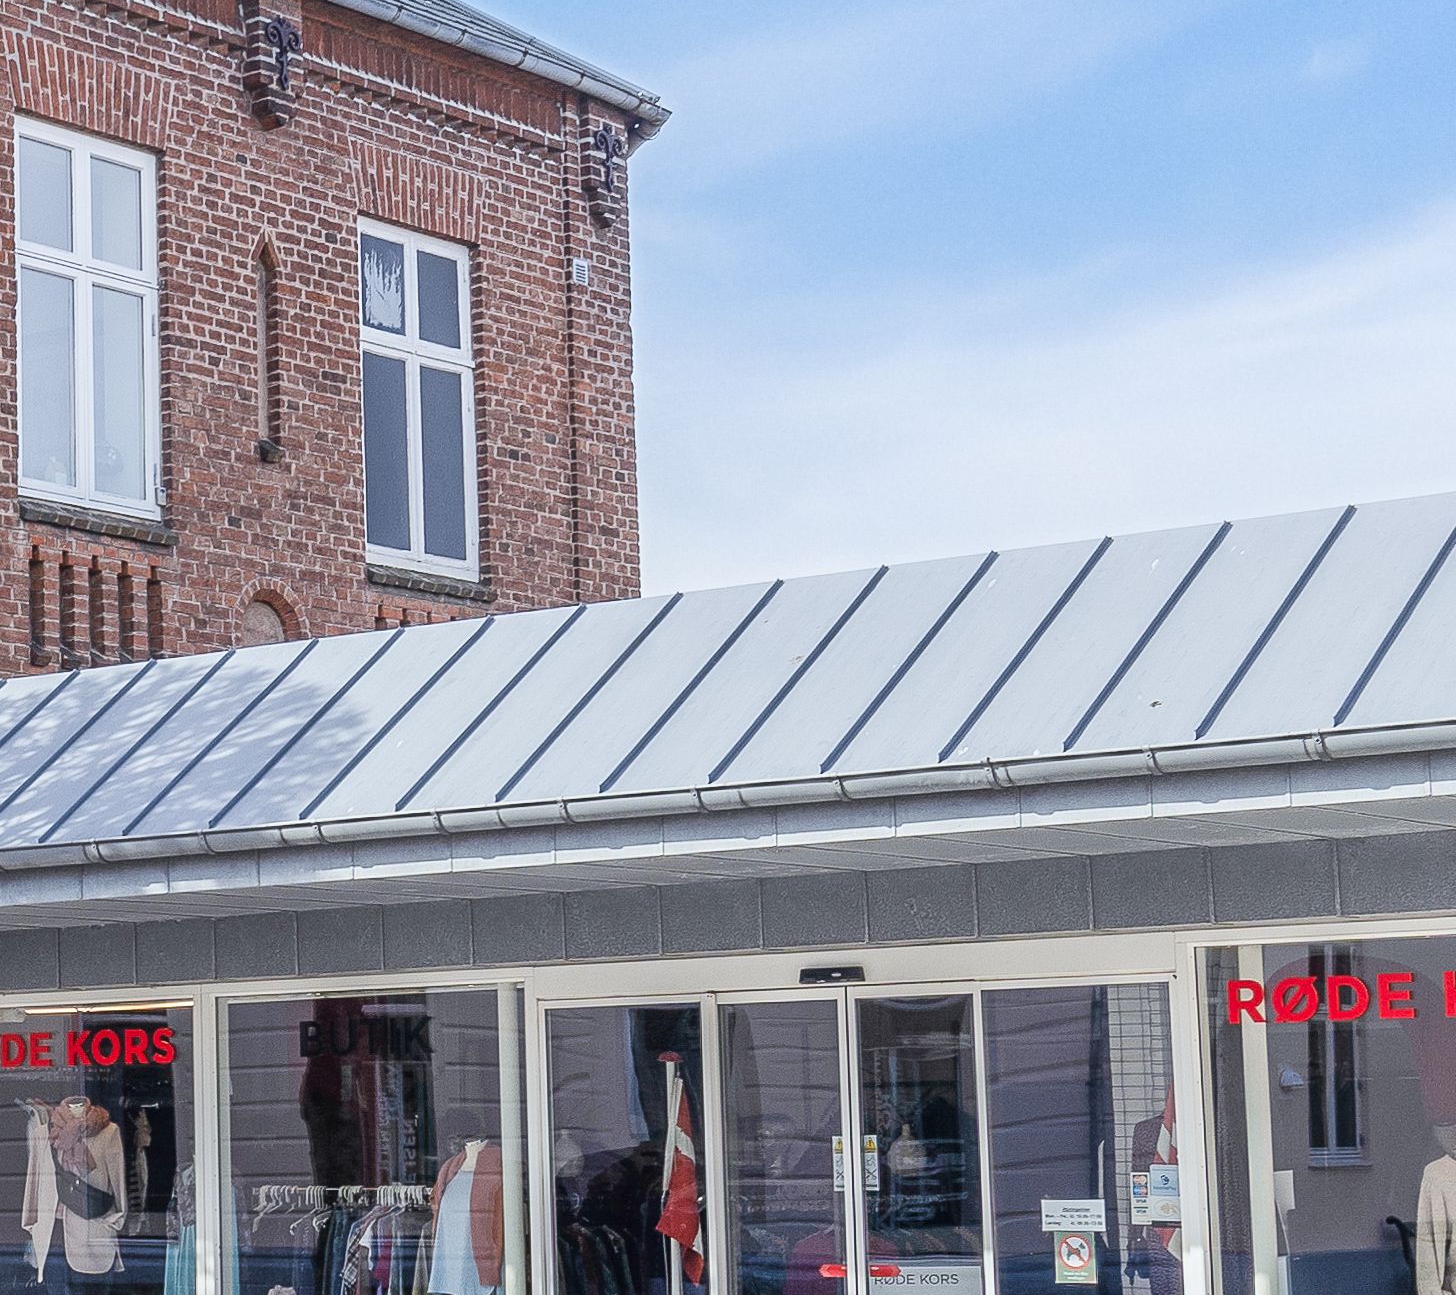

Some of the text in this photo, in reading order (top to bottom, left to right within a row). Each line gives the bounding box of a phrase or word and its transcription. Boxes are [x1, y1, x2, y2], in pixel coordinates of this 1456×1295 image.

[1226, 970, 1418, 1025] RØDE
[66, 1027, 176, 1067] KORS
[299, 1015, 434, 1058] BUTIK
[874, 1273, 959, 1285] RØDE KORS
